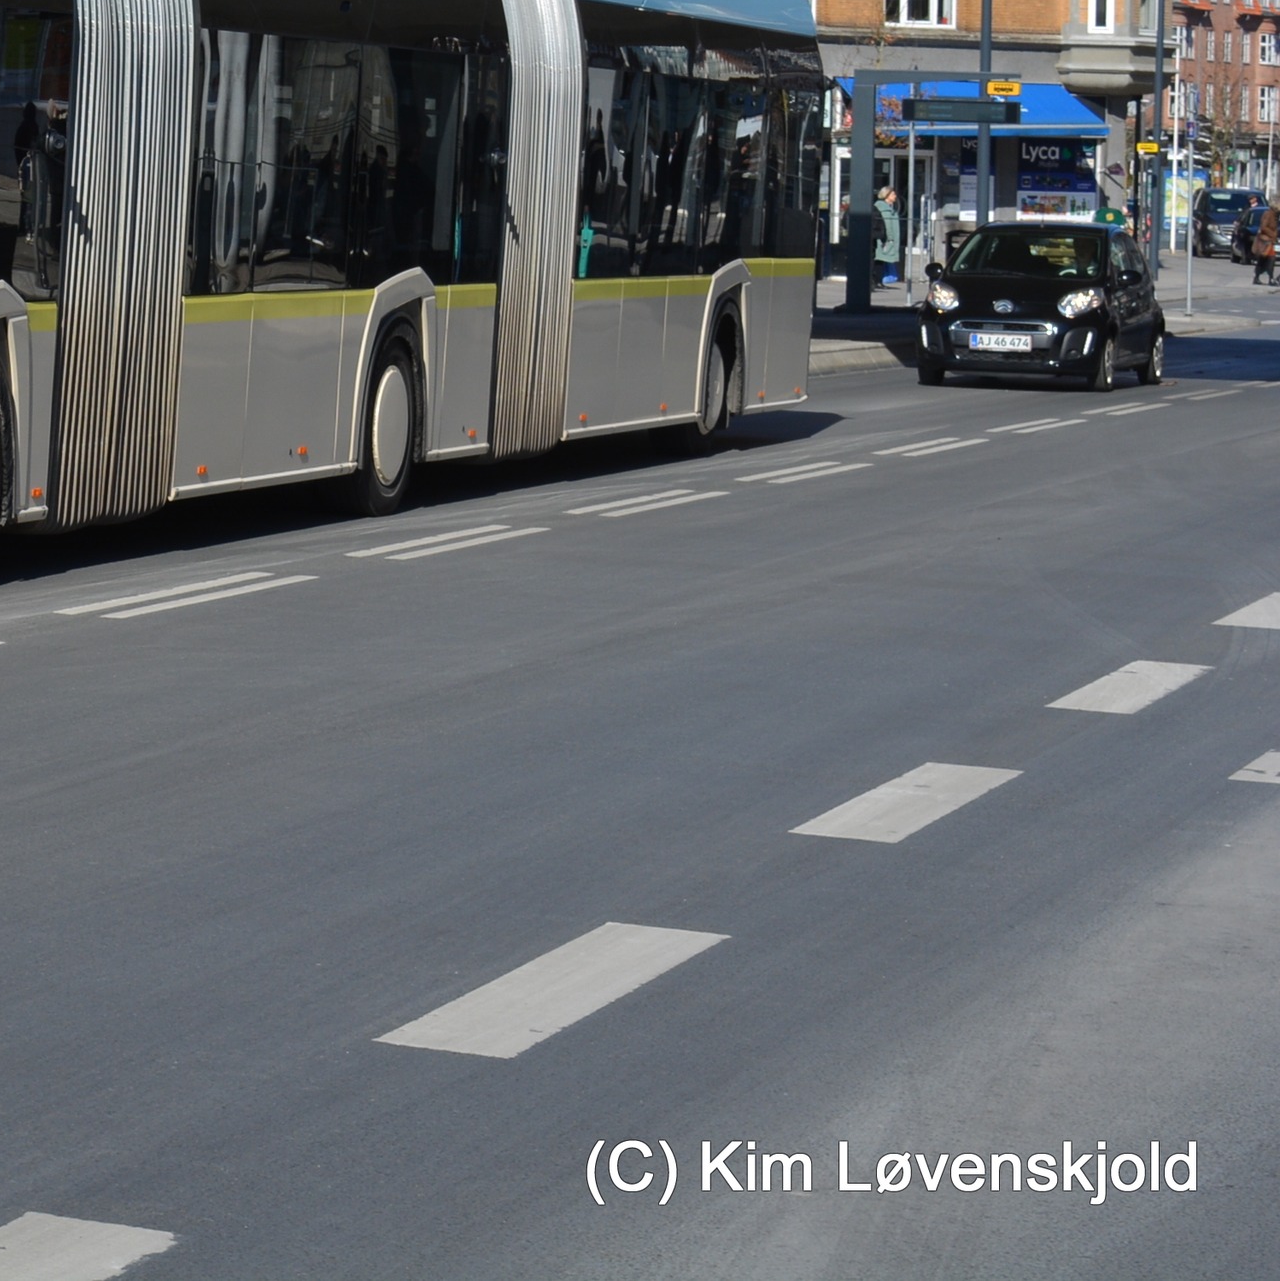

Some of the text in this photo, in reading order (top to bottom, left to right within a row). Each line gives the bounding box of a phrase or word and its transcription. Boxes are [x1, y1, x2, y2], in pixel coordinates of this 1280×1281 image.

[1021, 143, 1060, 161] Lyca
[978, 336, 1029, 348] AJ 46 474
